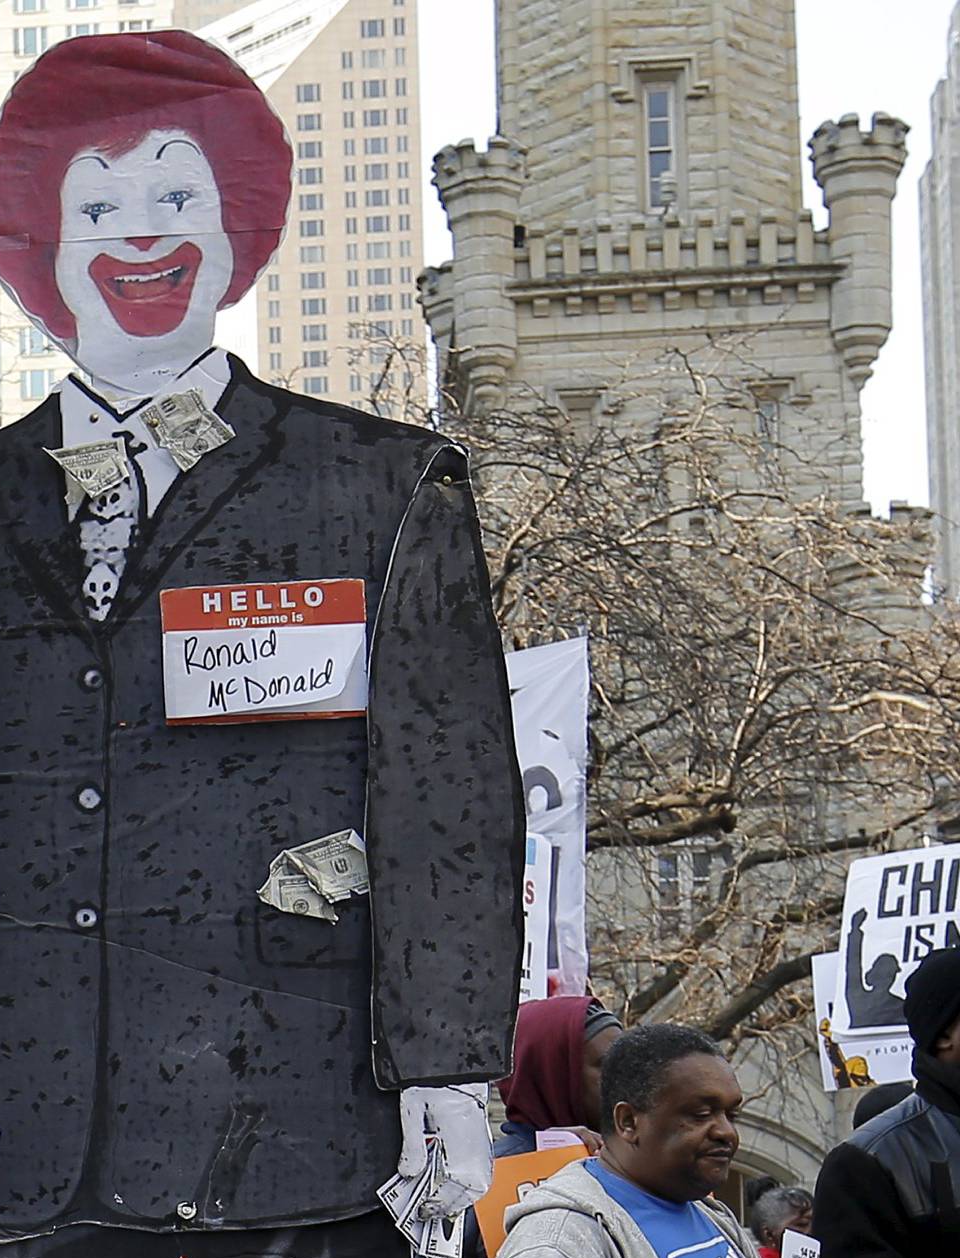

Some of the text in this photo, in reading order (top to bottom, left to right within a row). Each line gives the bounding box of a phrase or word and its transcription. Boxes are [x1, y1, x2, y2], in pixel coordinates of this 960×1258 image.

[202, 586, 324, 613] HELLO
[228, 612, 304, 628] my name is
[184, 629, 277, 675] Ronald
